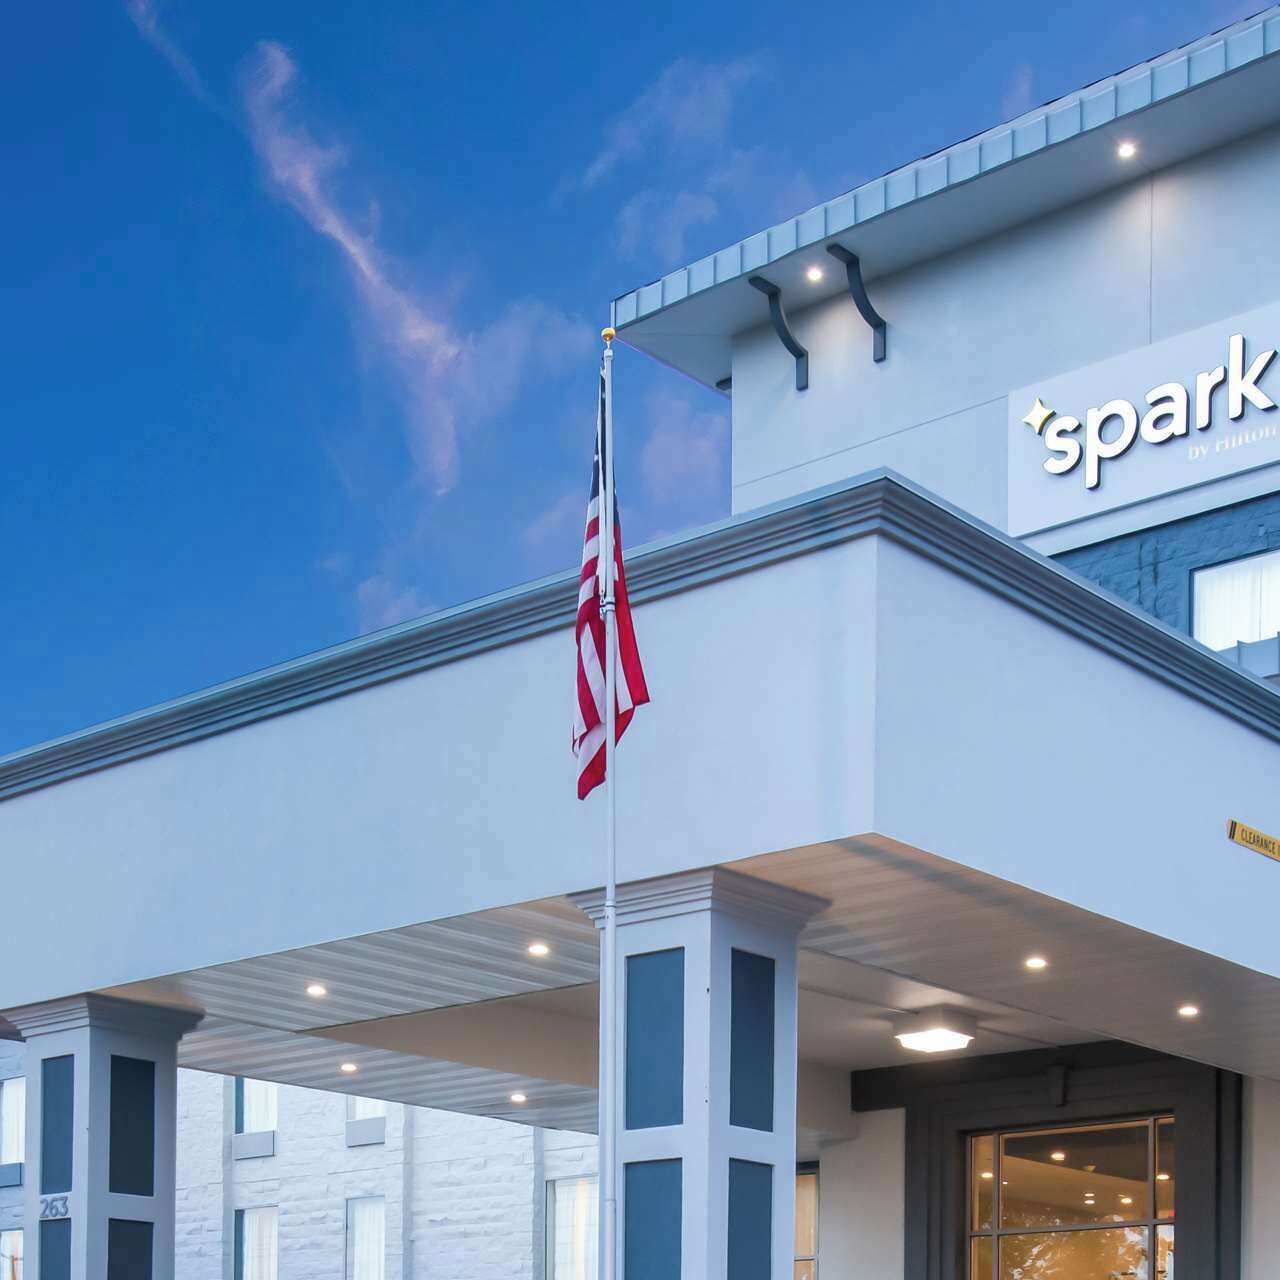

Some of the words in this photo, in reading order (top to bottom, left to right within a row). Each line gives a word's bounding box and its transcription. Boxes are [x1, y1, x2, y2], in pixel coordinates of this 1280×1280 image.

[1043, 334, 1278, 489] spark
[1187, 443, 1209, 463] by
[1214, 425, 1277, 454] Hilton
[1241, 828, 1276, 855] CLEARANCE
[40, 1196, 69, 1218] 263
